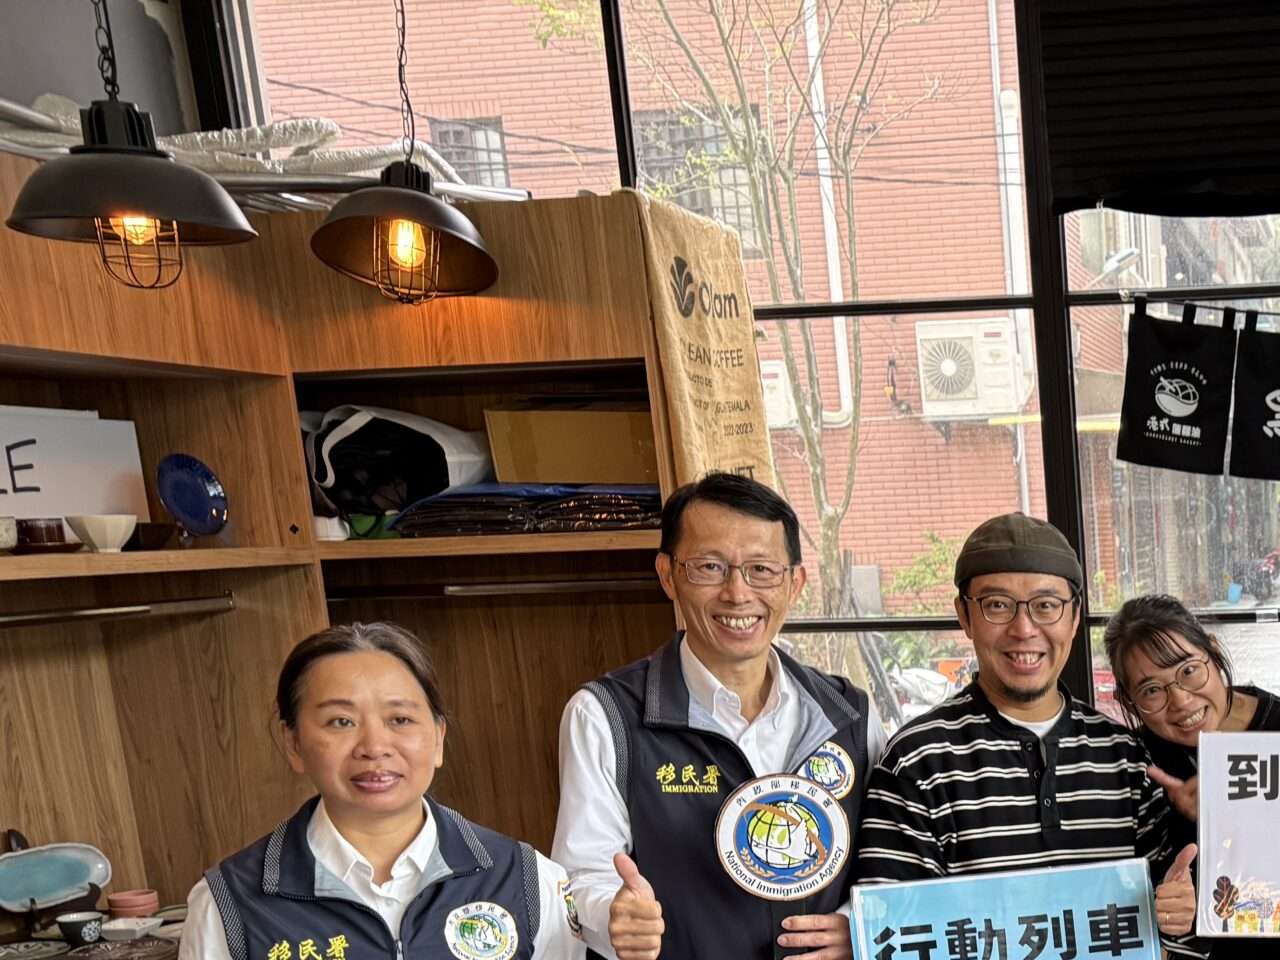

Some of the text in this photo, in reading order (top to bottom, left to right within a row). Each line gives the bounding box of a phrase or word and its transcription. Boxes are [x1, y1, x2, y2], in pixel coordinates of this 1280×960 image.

[0, 438, 41, 494] E
[656, 762, 721, 787] 移民署
[662, 784, 718, 793] IMMIGRATION
[724, 846, 845, 896] National Immigration Agency
